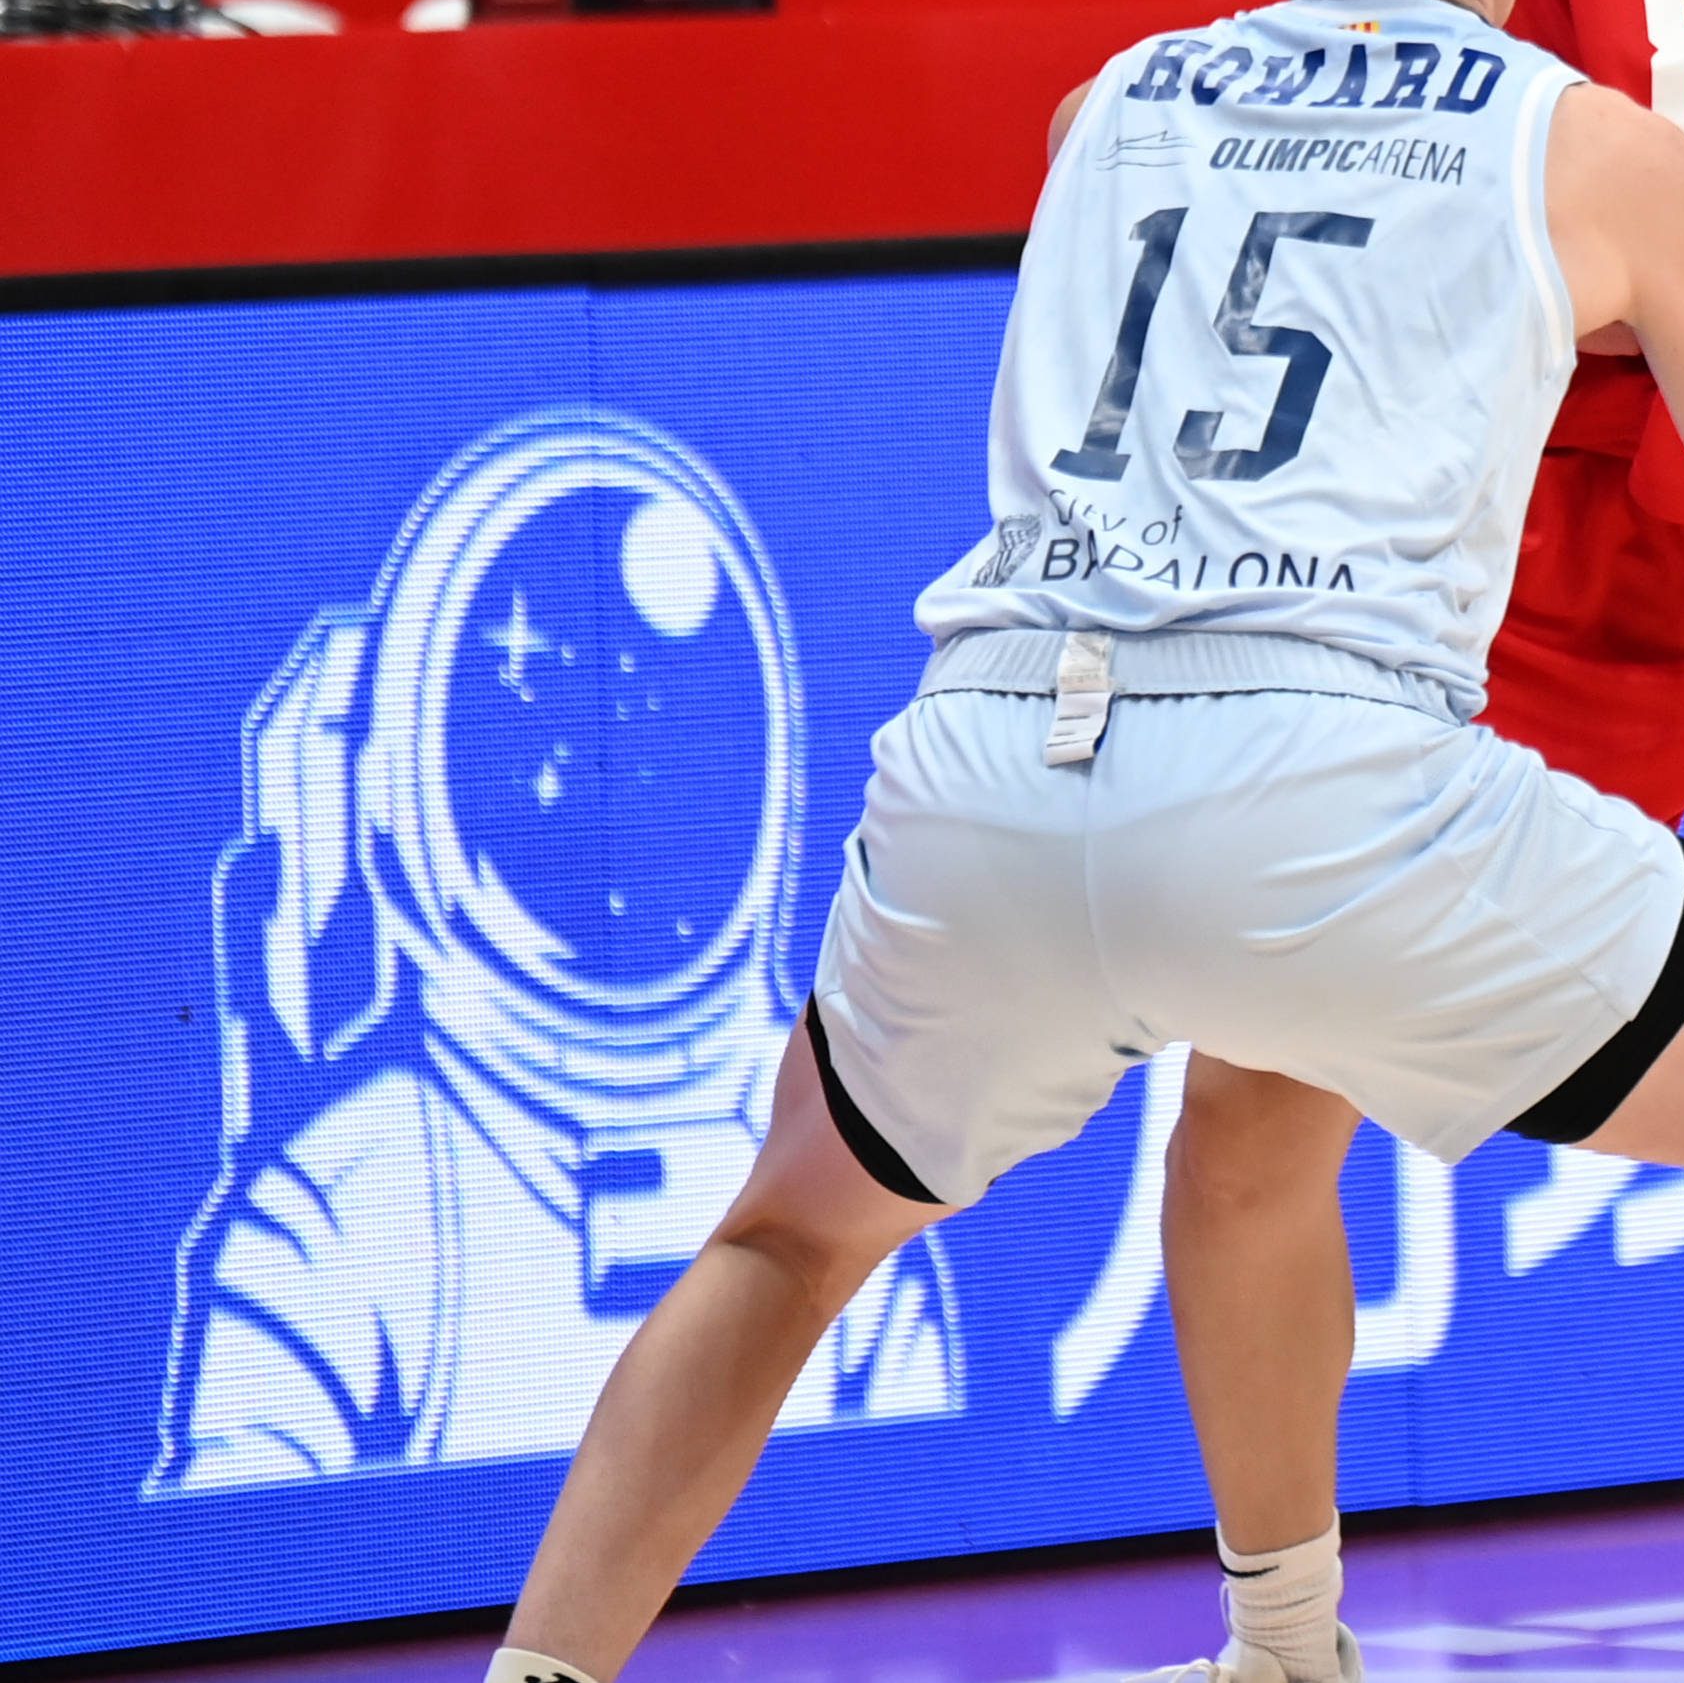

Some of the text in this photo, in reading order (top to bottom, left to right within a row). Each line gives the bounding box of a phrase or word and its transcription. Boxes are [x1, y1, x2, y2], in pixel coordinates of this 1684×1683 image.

[1125, 38, 1507, 114] HOWARD
[1049, 206, 1376, 482] 15
[1140, 504, 1184, 546] of
